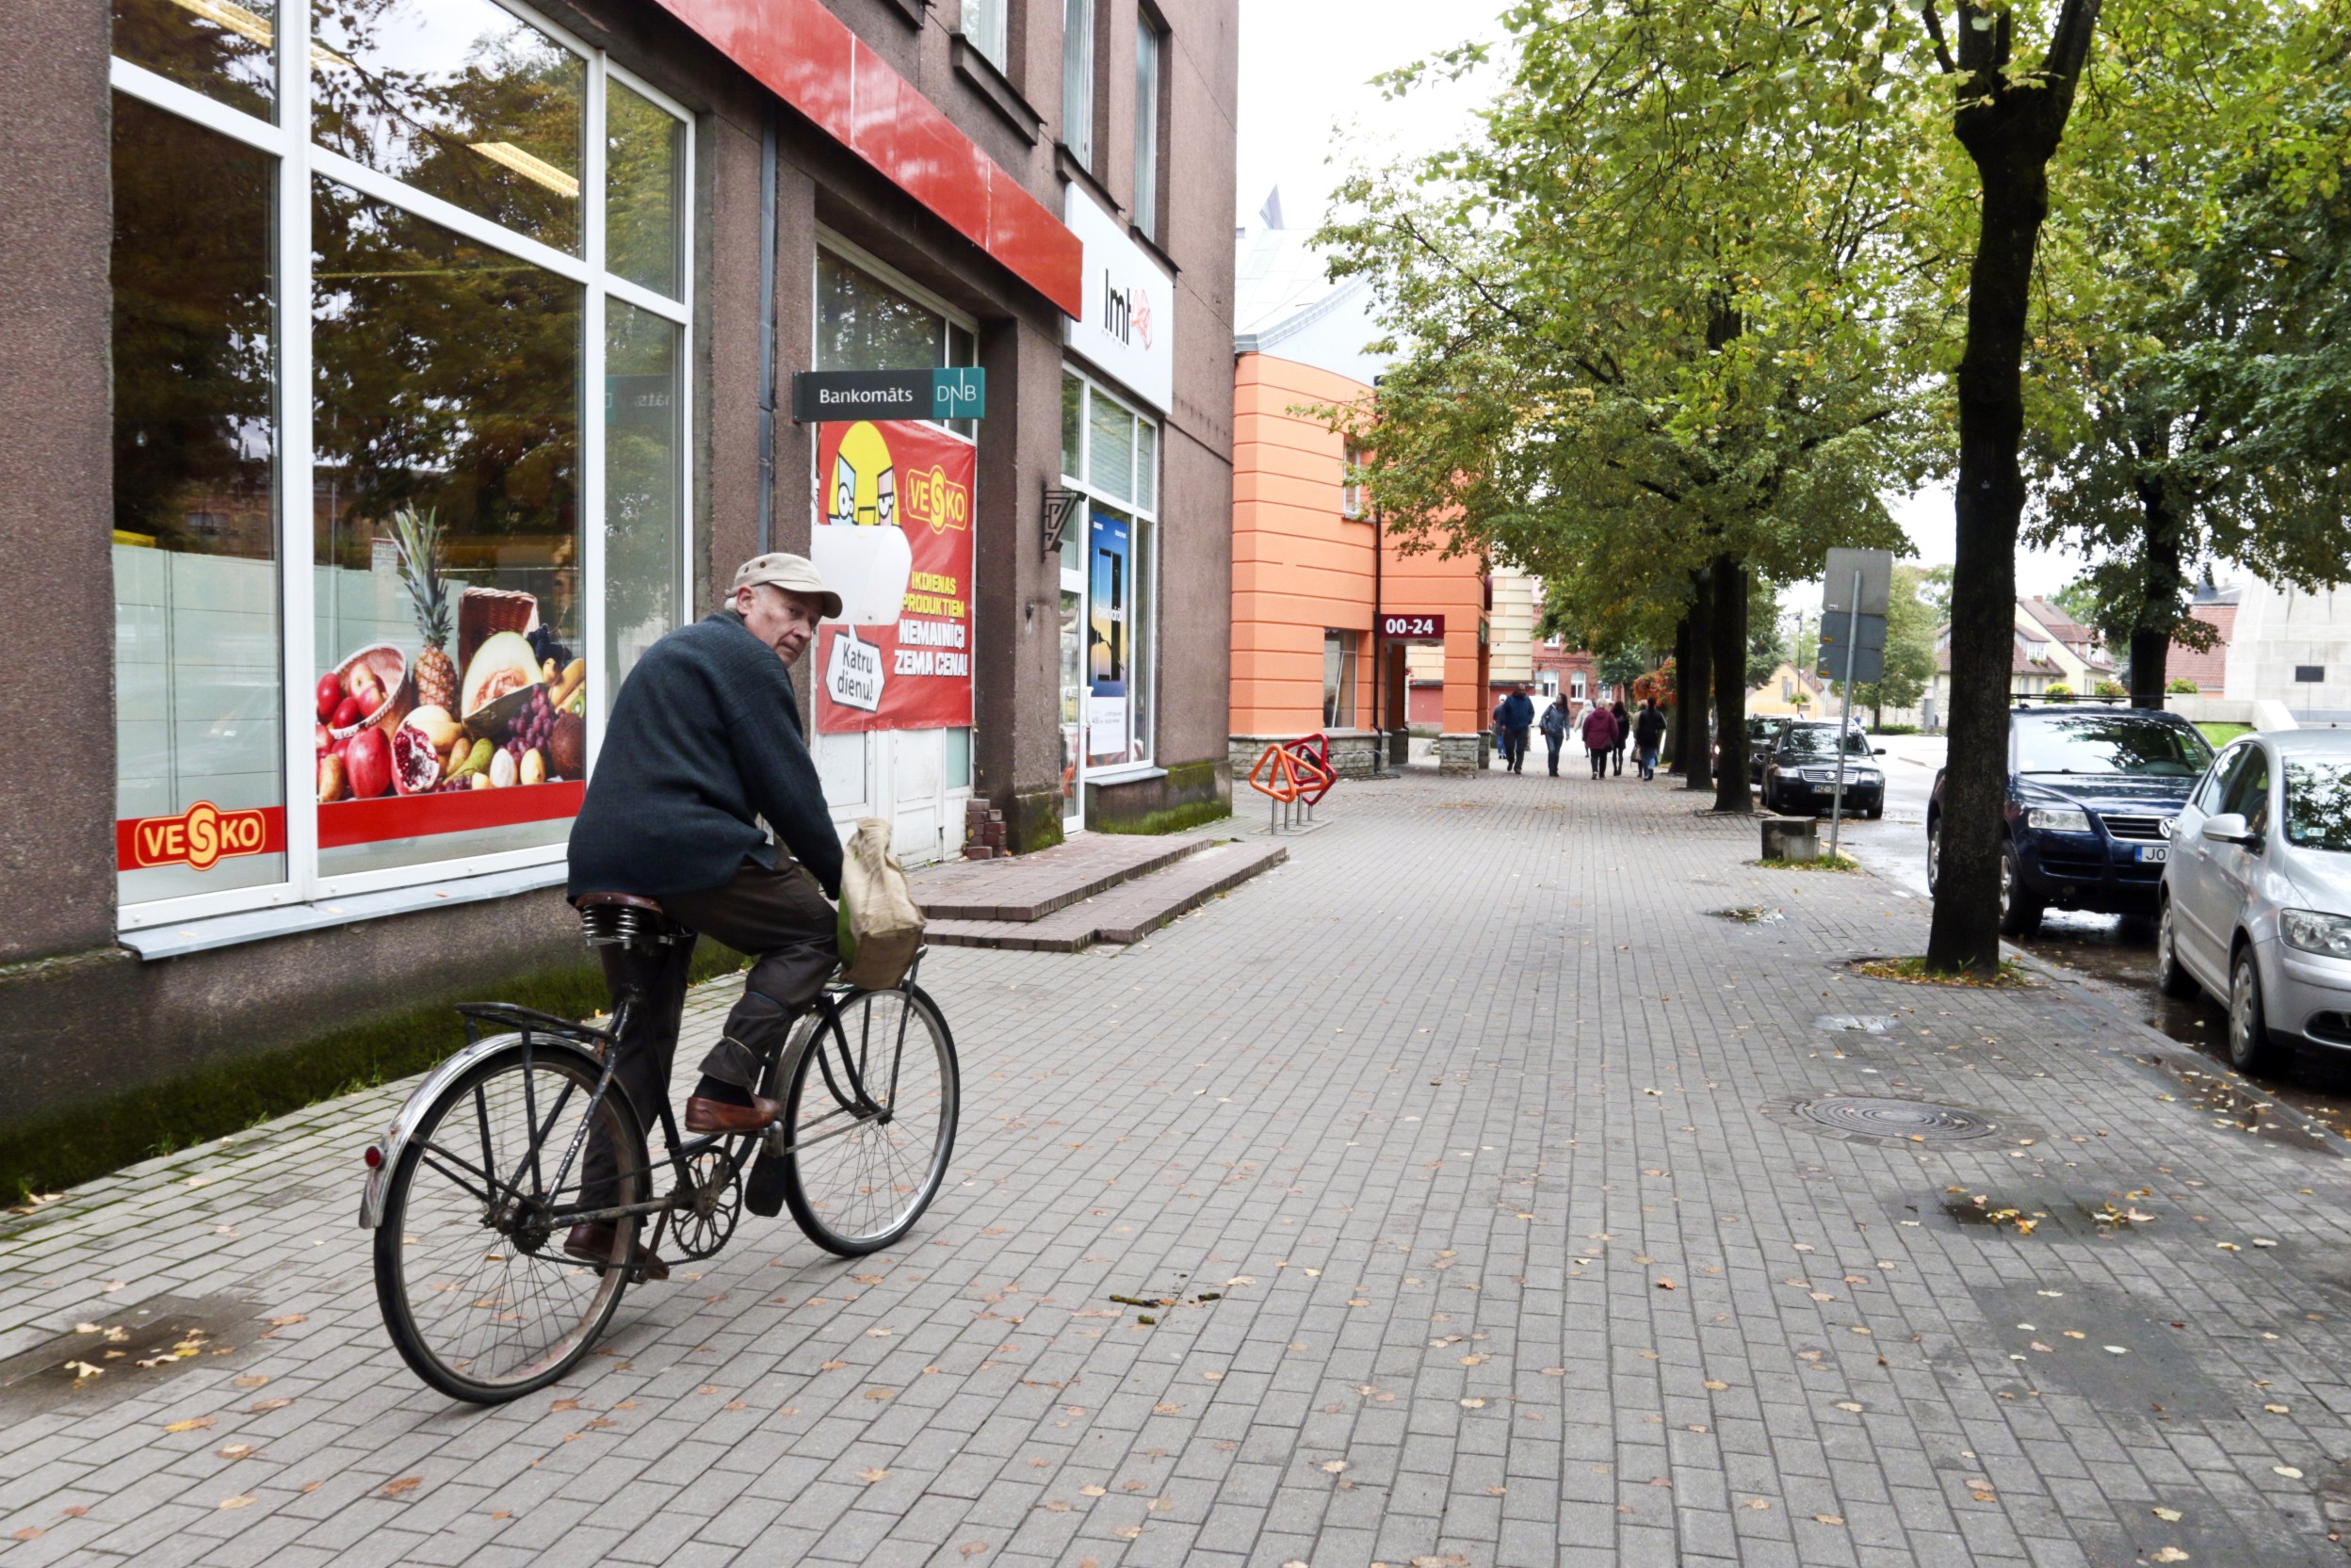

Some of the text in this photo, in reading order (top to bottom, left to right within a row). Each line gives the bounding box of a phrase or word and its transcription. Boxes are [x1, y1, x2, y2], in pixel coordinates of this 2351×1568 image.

[1105, 268, 1131, 346] lmt
[819, 368, 976, 418] Bankomāts DNB
[910, 472, 965, 527] VESKO
[912, 571, 956, 595] IKDIENAS
[901, 593, 965, 618] PRODUKTIEM
[1386, 619, 1434, 634] 00-24
[843, 642, 872, 674] Katru
[894, 650, 967, 676] ZEMA CENA!
[837, 669, 872, 701] dienu!
[144, 807, 260, 864] VESKO
